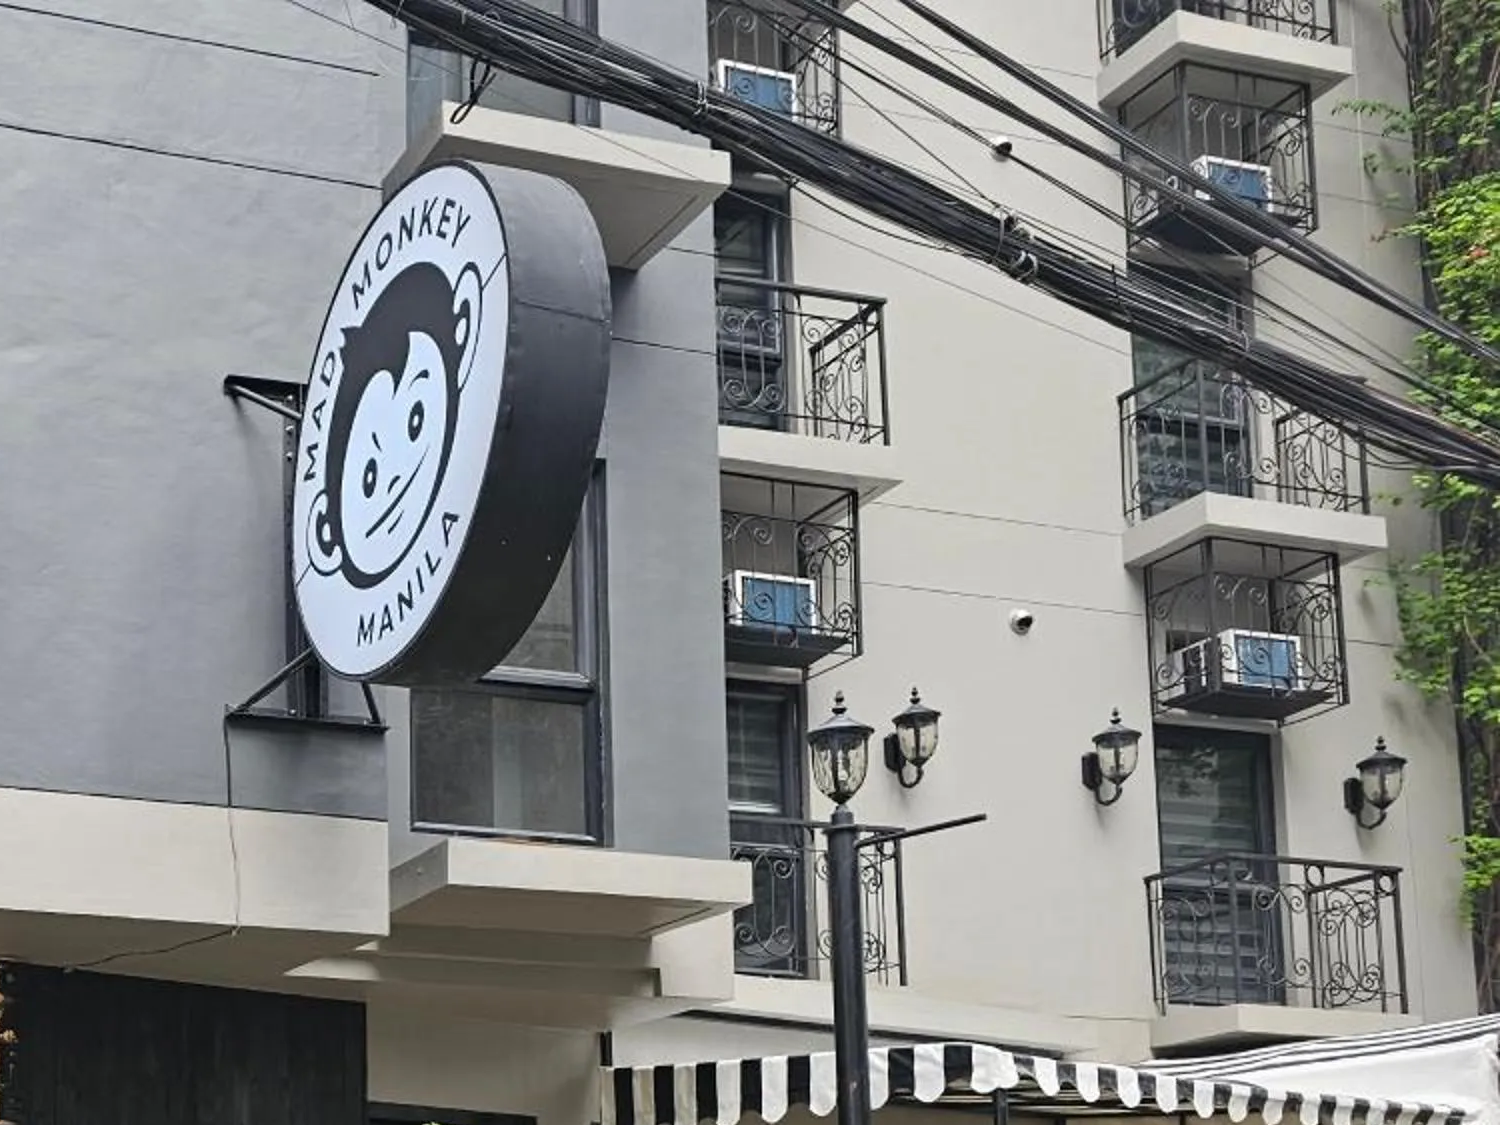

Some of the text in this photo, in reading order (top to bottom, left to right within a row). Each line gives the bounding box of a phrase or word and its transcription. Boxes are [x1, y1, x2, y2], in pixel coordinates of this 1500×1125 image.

[303, 196, 471, 483] MAD MONKEY
[356, 508, 461, 648] MANILA
